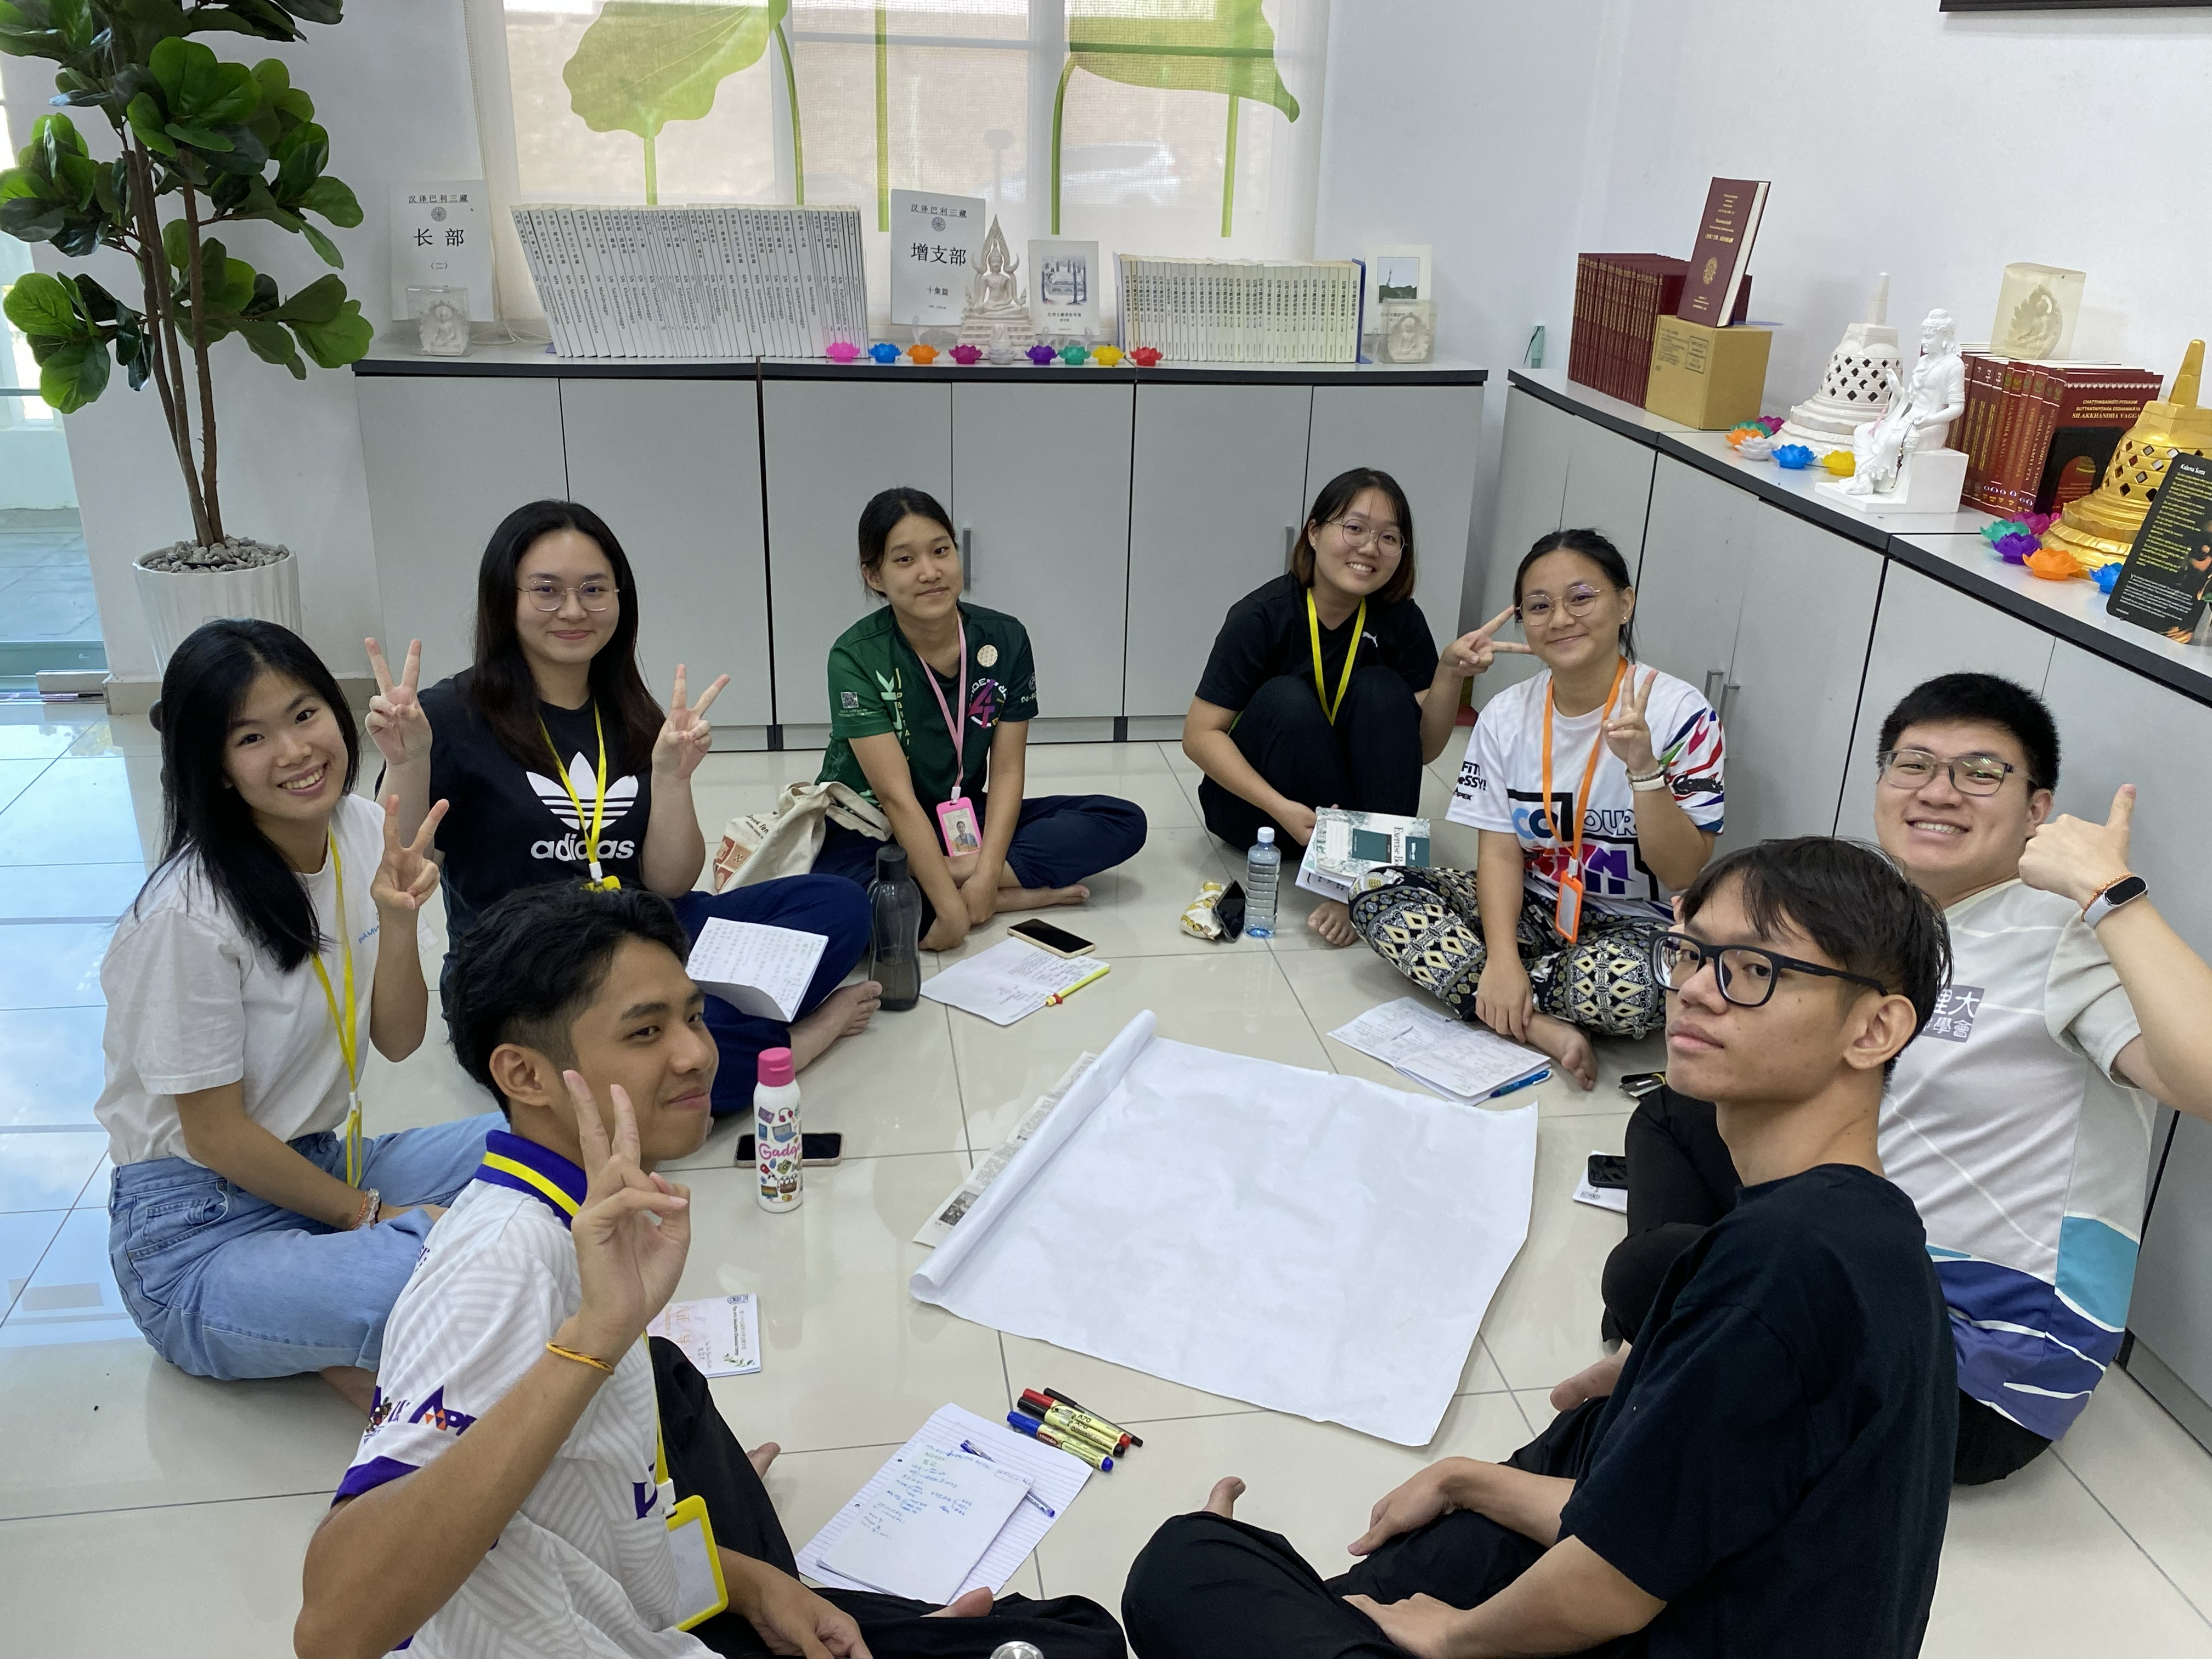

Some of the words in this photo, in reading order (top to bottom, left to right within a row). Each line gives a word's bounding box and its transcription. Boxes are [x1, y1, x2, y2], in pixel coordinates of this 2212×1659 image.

[414, 228, 465, 247] 长部
[911, 243, 967, 267] 增支部
[1393, 826, 1404, 855] Exercise
[1077, 1414, 1091, 1423] A70
